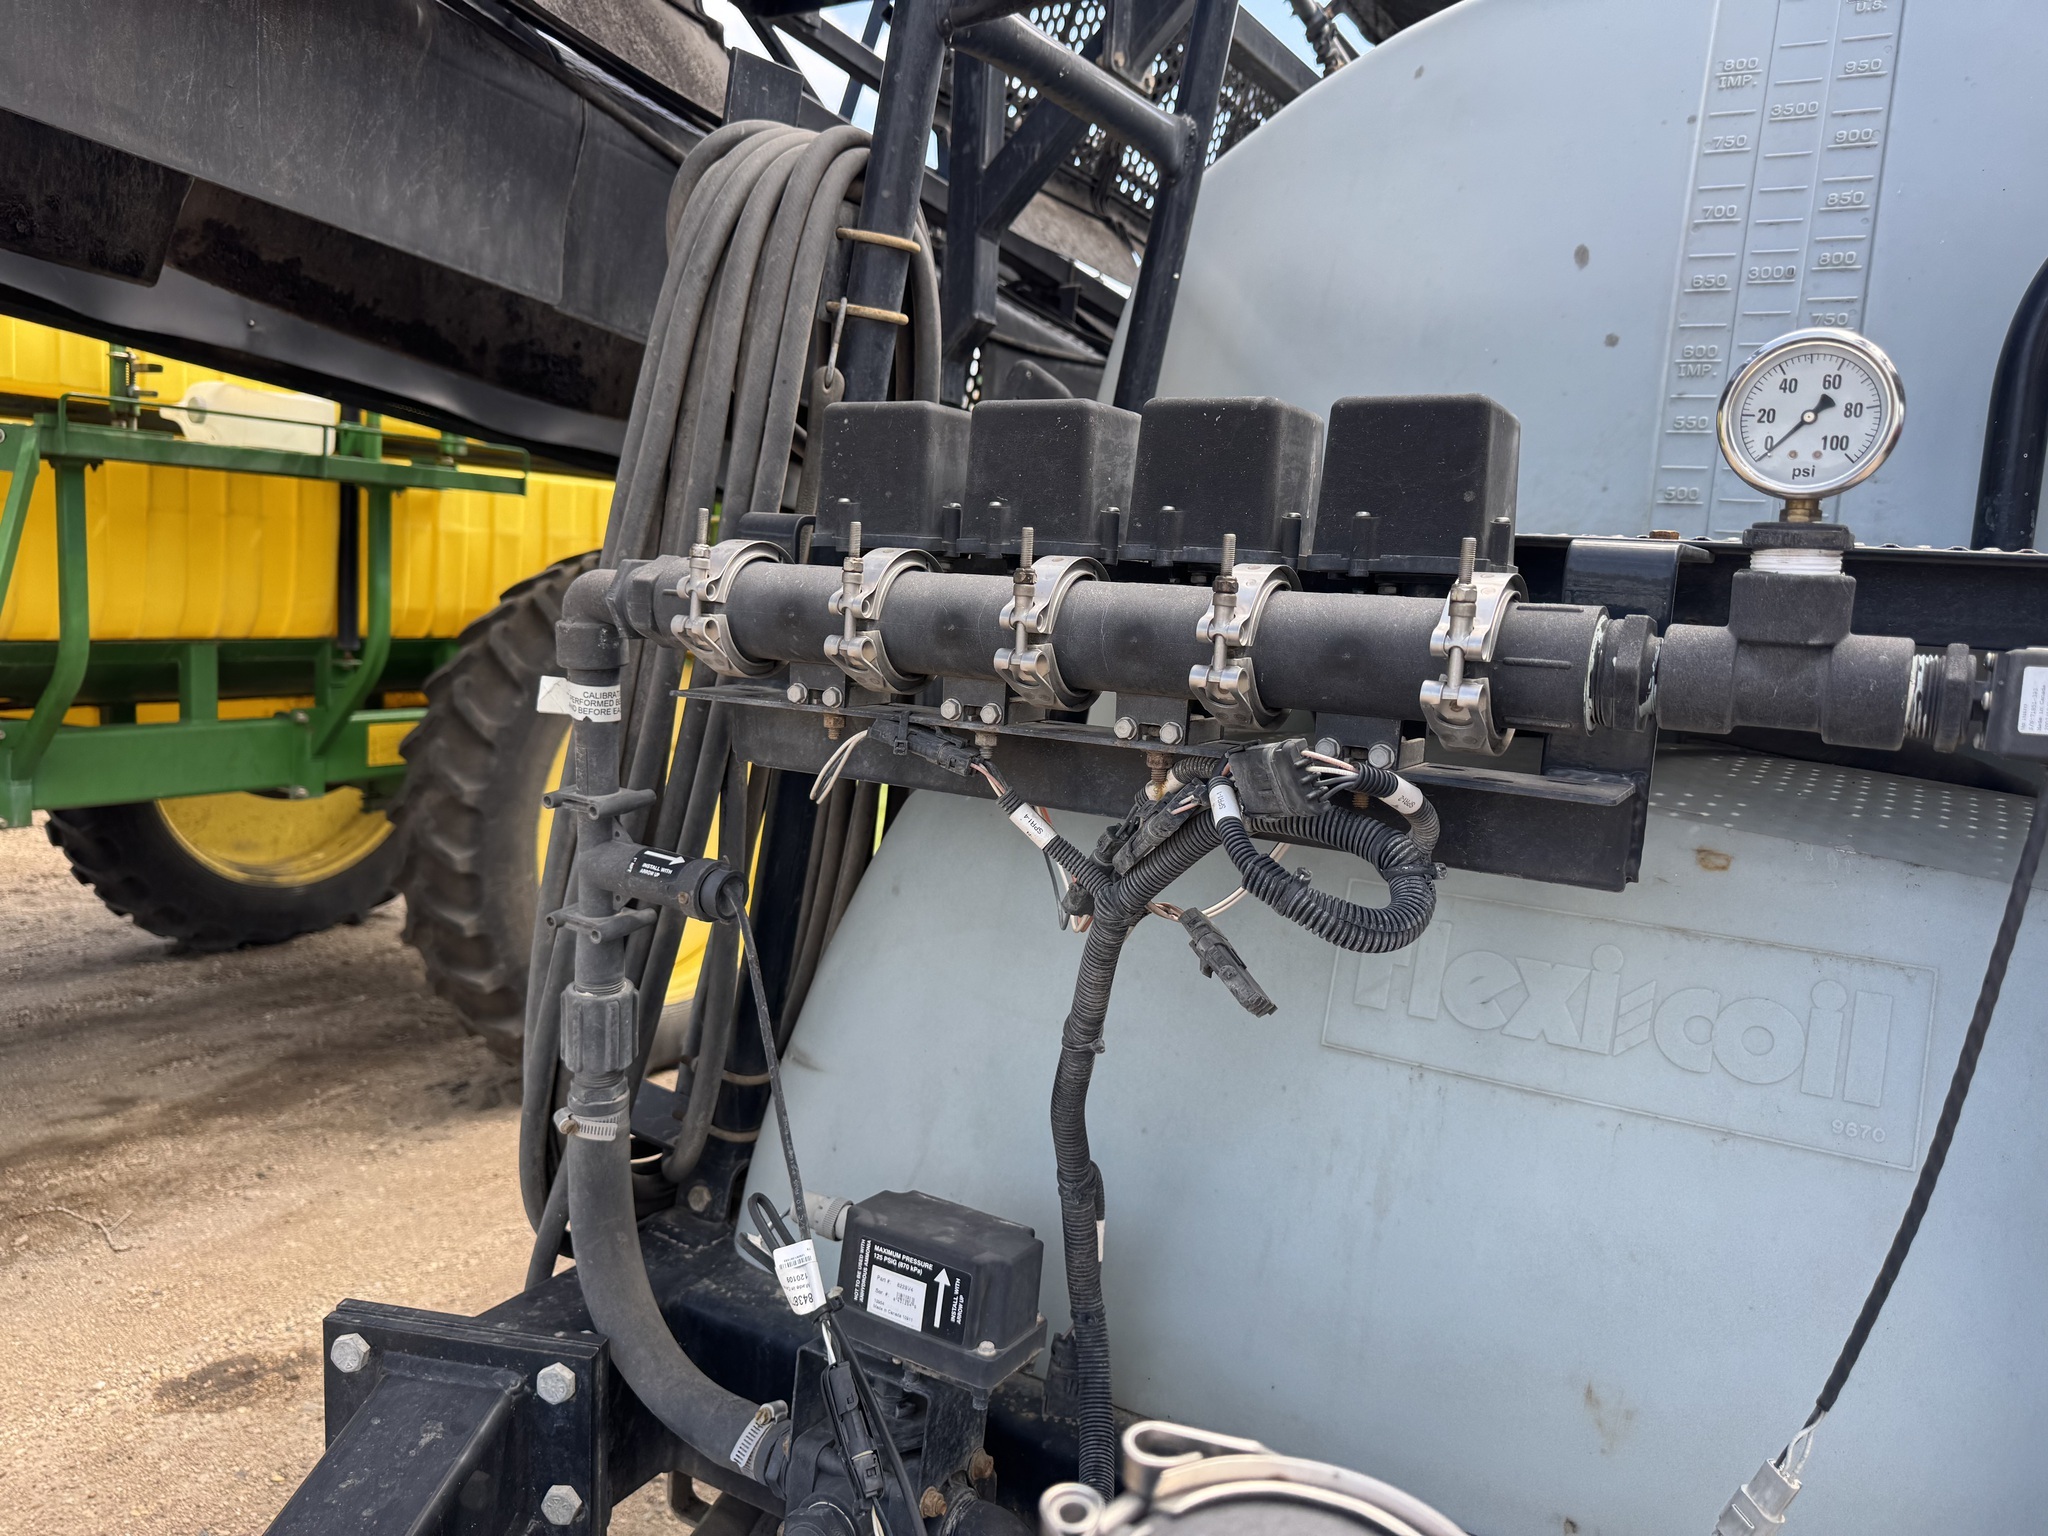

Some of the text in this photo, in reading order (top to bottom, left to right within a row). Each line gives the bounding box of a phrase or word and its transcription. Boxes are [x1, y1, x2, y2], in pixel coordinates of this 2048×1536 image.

[1723, 57, 1759, 71] 800
[1845, 59, 1882, 74] 950
[1717, 75, 1758, 90] IMP.
[1771, 101, 1819, 116] 3500
[1712, 135, 1748, 149] 750
[1835, 128, 1874, 143] 900
[1826, 191, 1865, 206] 850
[1703, 204, 1738, 218] 700
[1819, 251, 1857, 265] 800
[1748, 265, 1797, 280] 3000
[1691, 274, 1728, 289] 650
[1812, 312, 1849, 326] 750
[1682, 345, 1718, 359] 600
[1678, 363, 1718, 378] IMP.
[1779, 378, 1798, 394] 40
[1822, 374, 1842, 390] 60
[1757, 408, 1776, 424] 20
[1843, 402, 1863, 419] 80
[1673, 416, 1709, 430] 550
[1764, 435, 1774, 451] 0
[1821, 435, 1850, 451] 100
[1791, 464, 1816, 479] psi
[1664, 487, 1700, 500] 500
[578, 706, 611, 716] BEFORE
[1831, 1119, 1886, 1143] 9670
[873, 1252, 884, 1261] 125
[883, 1256, 897, 1267] PSIG
[909, 1265, 923, 1276] kPa)
[874, 1244, 934, 1271] MAXIMUM PRESSURE
[859, 1267, 868, 1302] ANHYDROUS
[950, 1278, 961, 1323] INSTALL WITH
[956, 1294, 965, 1325] ARROW UP
